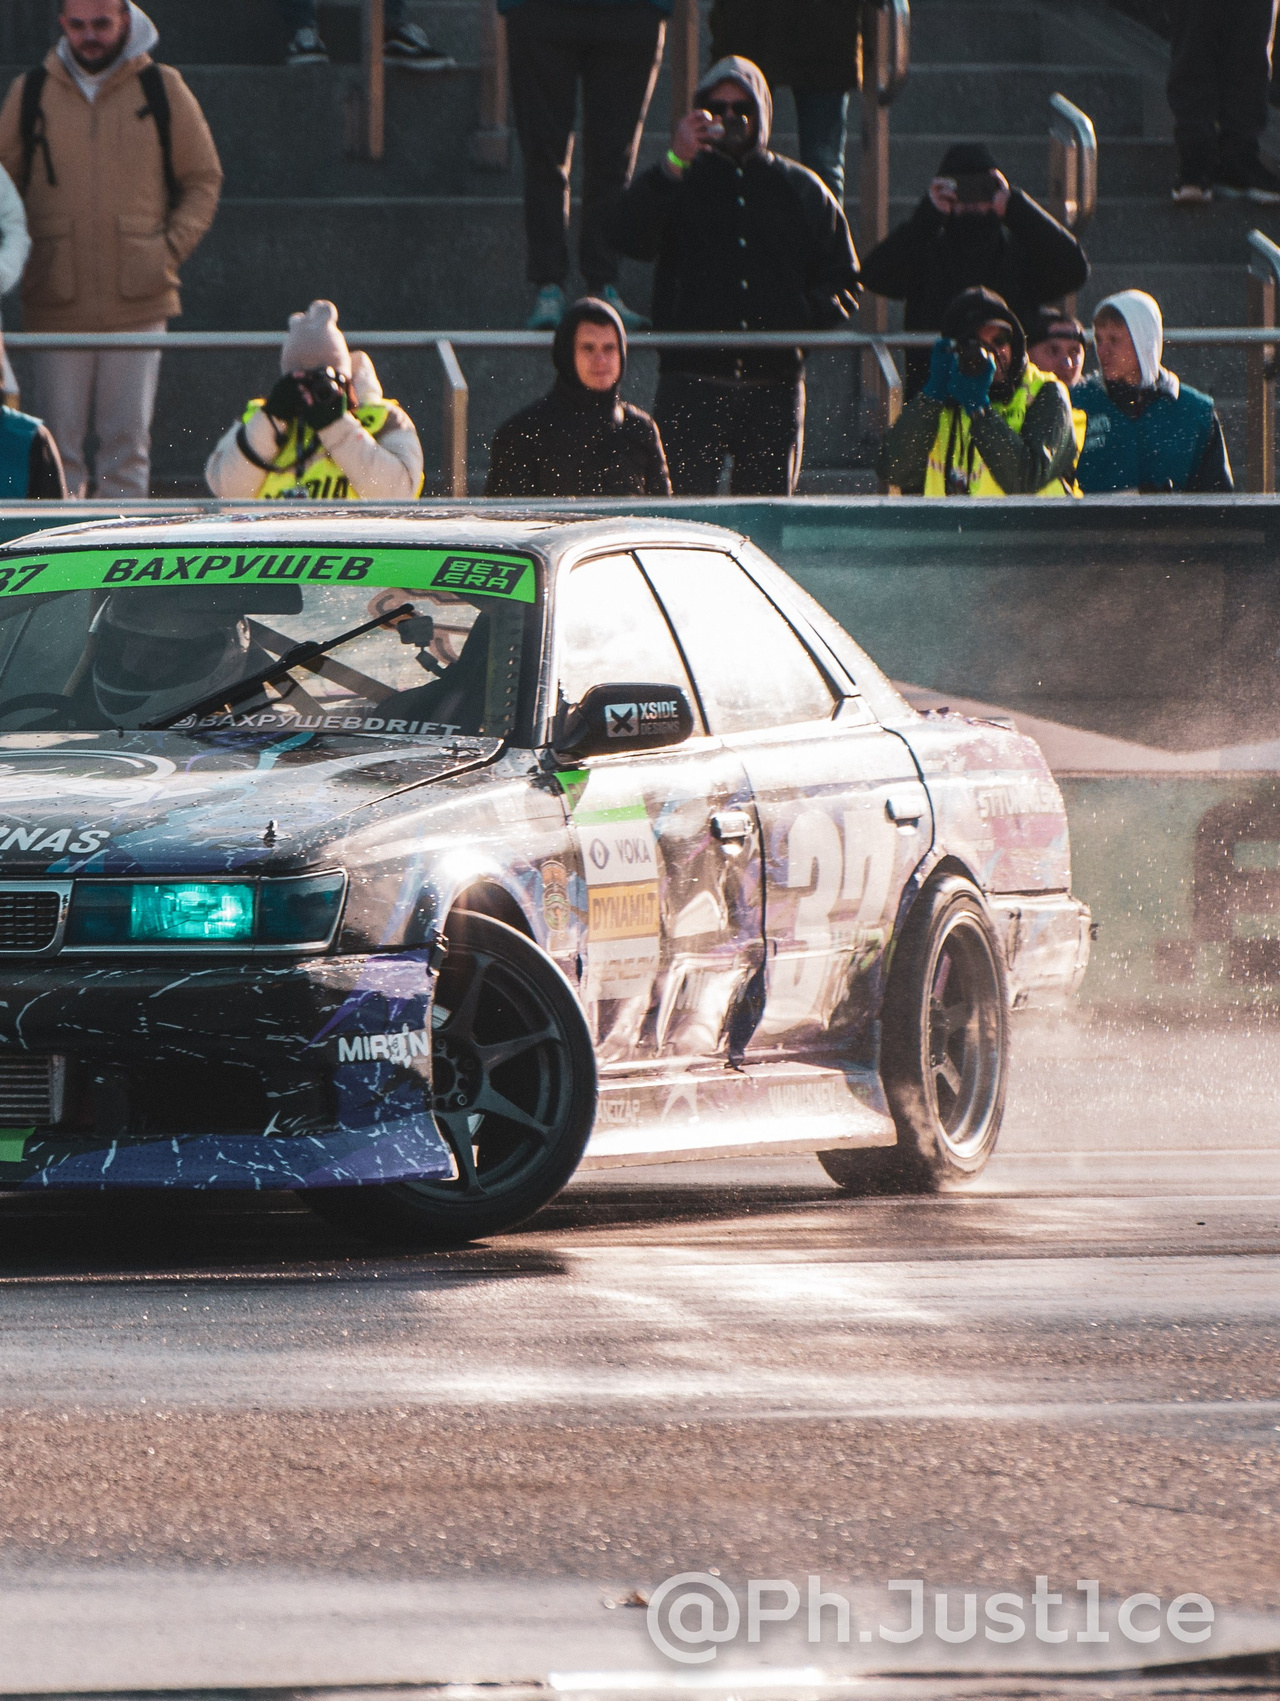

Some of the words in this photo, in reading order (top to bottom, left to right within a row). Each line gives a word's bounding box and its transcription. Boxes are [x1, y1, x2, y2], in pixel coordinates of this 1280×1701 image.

[102, 555, 375, 583] ВАХРУШЕВ
[448, 560, 517, 577] BET
[639, 701, 679, 720] XSIDE
